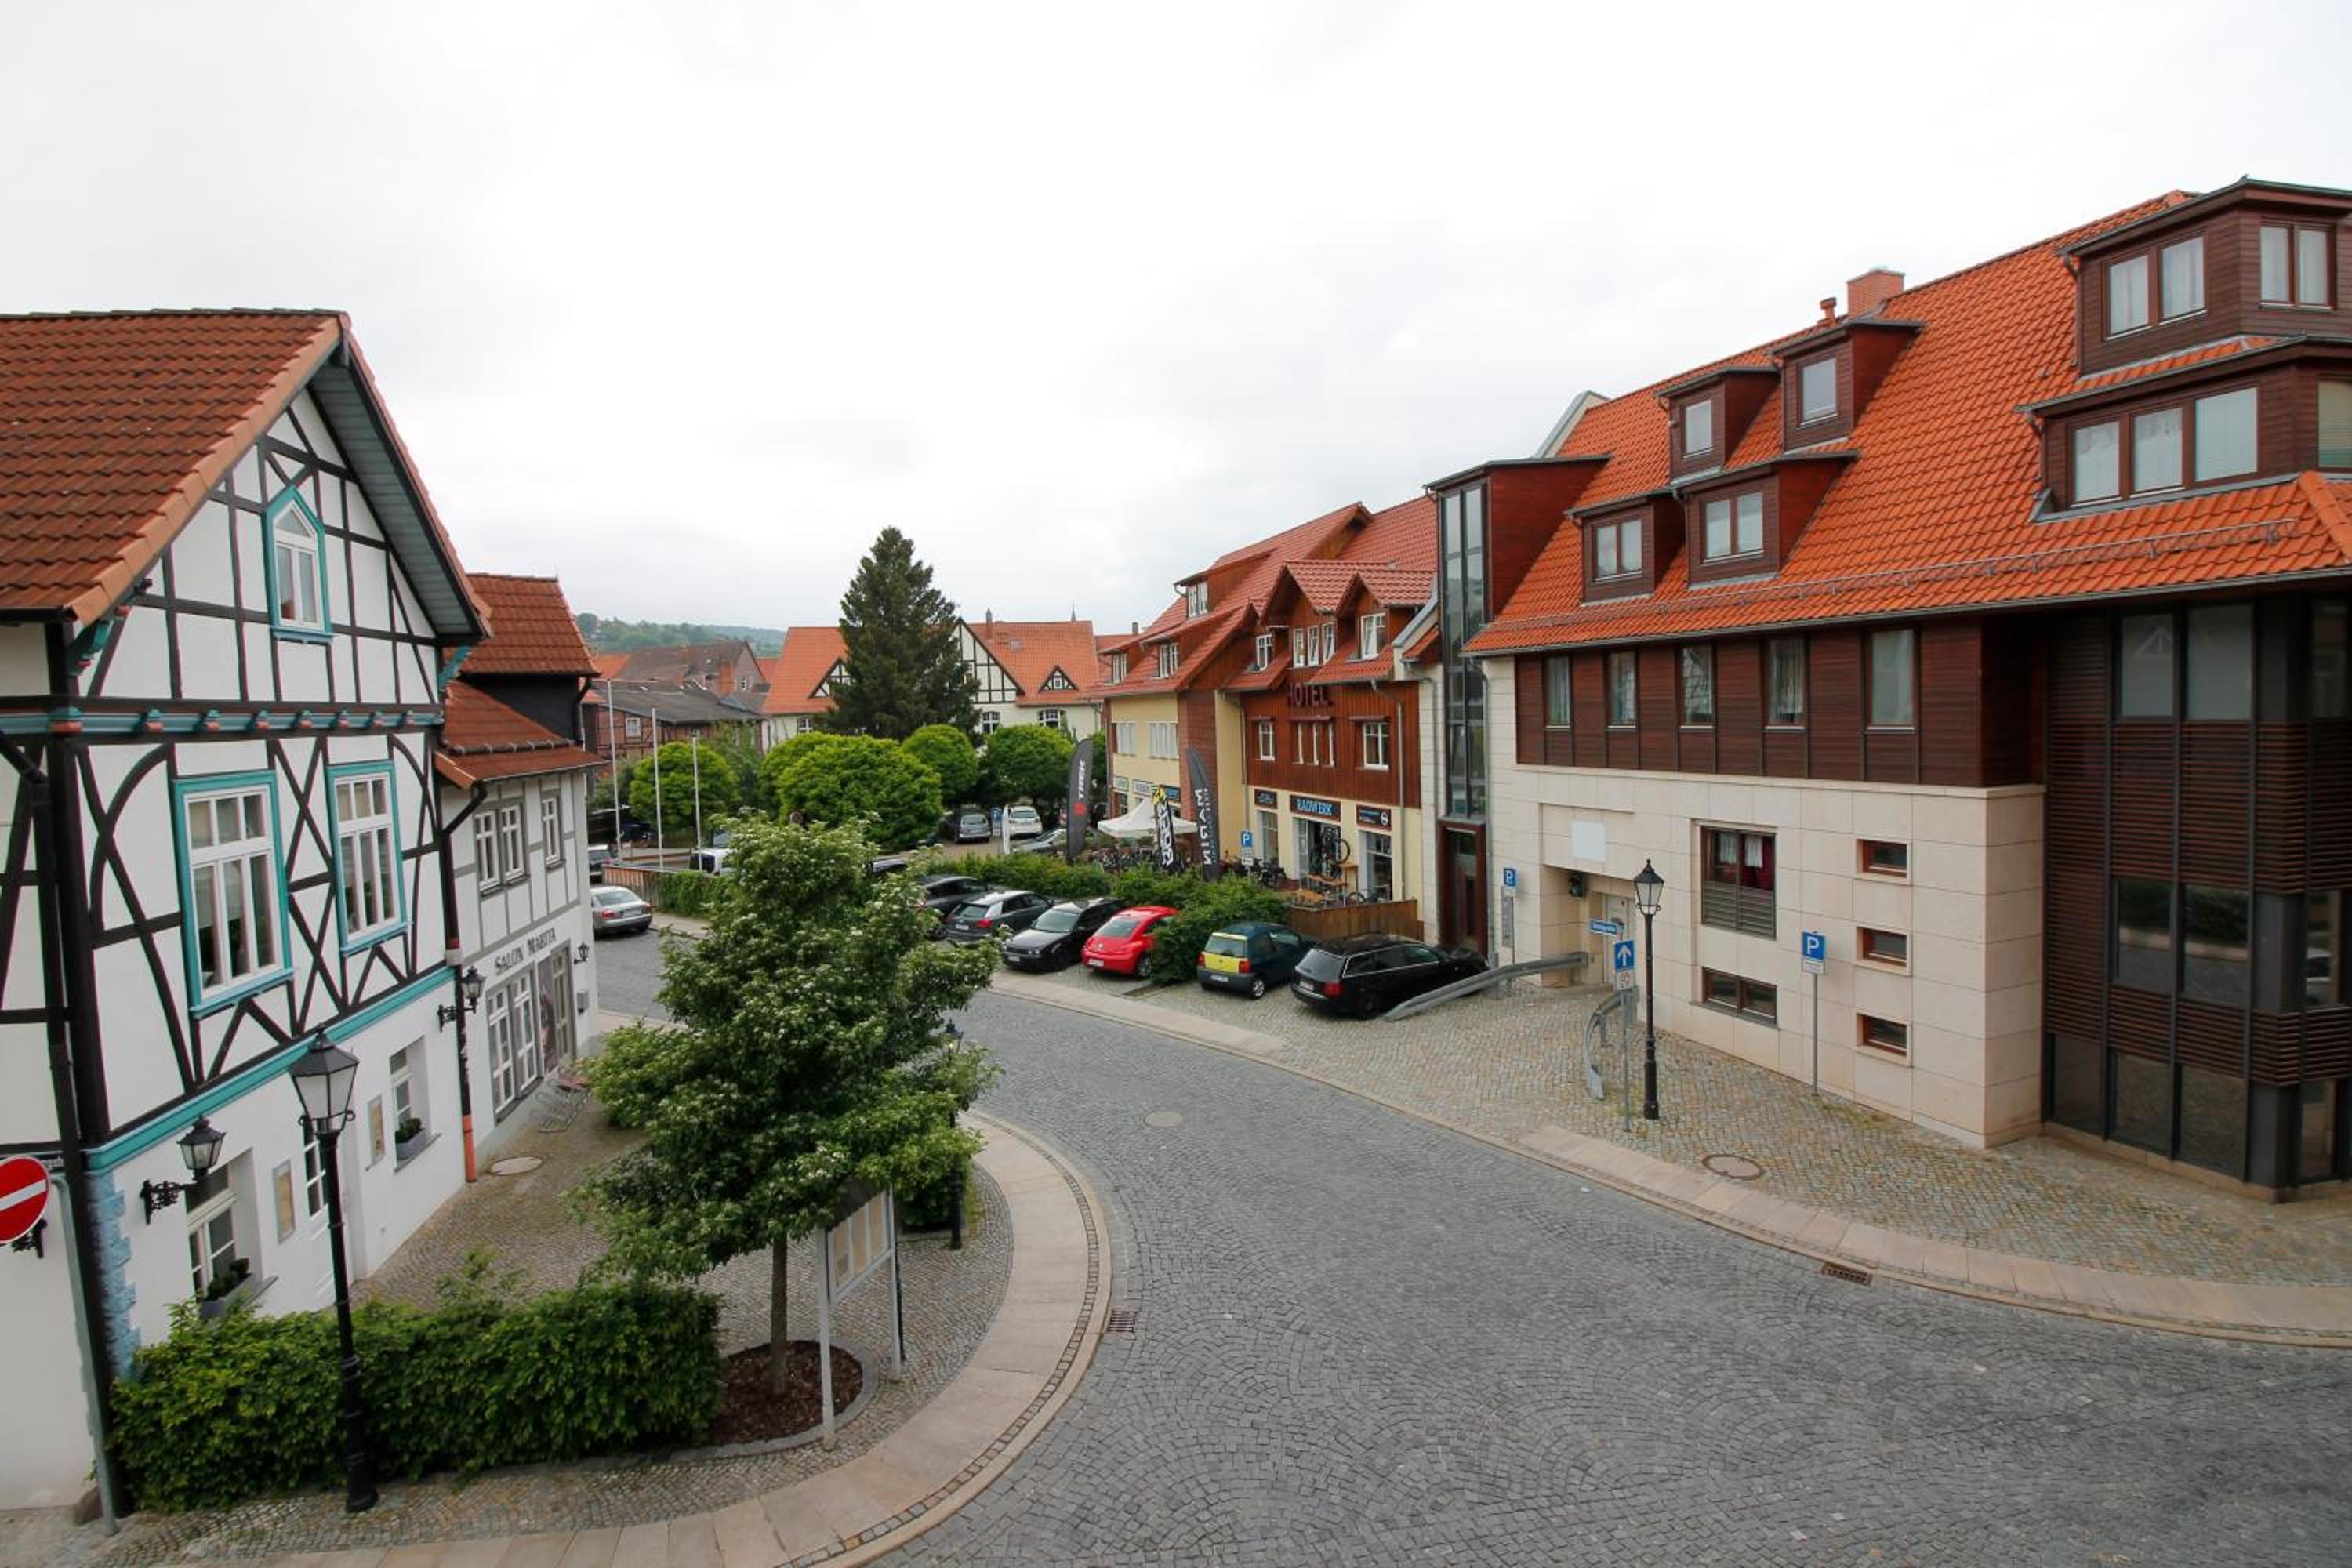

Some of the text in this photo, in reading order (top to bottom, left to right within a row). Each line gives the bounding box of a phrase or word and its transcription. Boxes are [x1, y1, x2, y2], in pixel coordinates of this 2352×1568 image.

[1288, 681, 1330, 707] HOTEL
[1296, 798, 1332, 815] RADWERK
[1243, 833, 1250, 846] P
[1807, 936, 1820, 954] P
[495, 946, 524, 970] SALON
